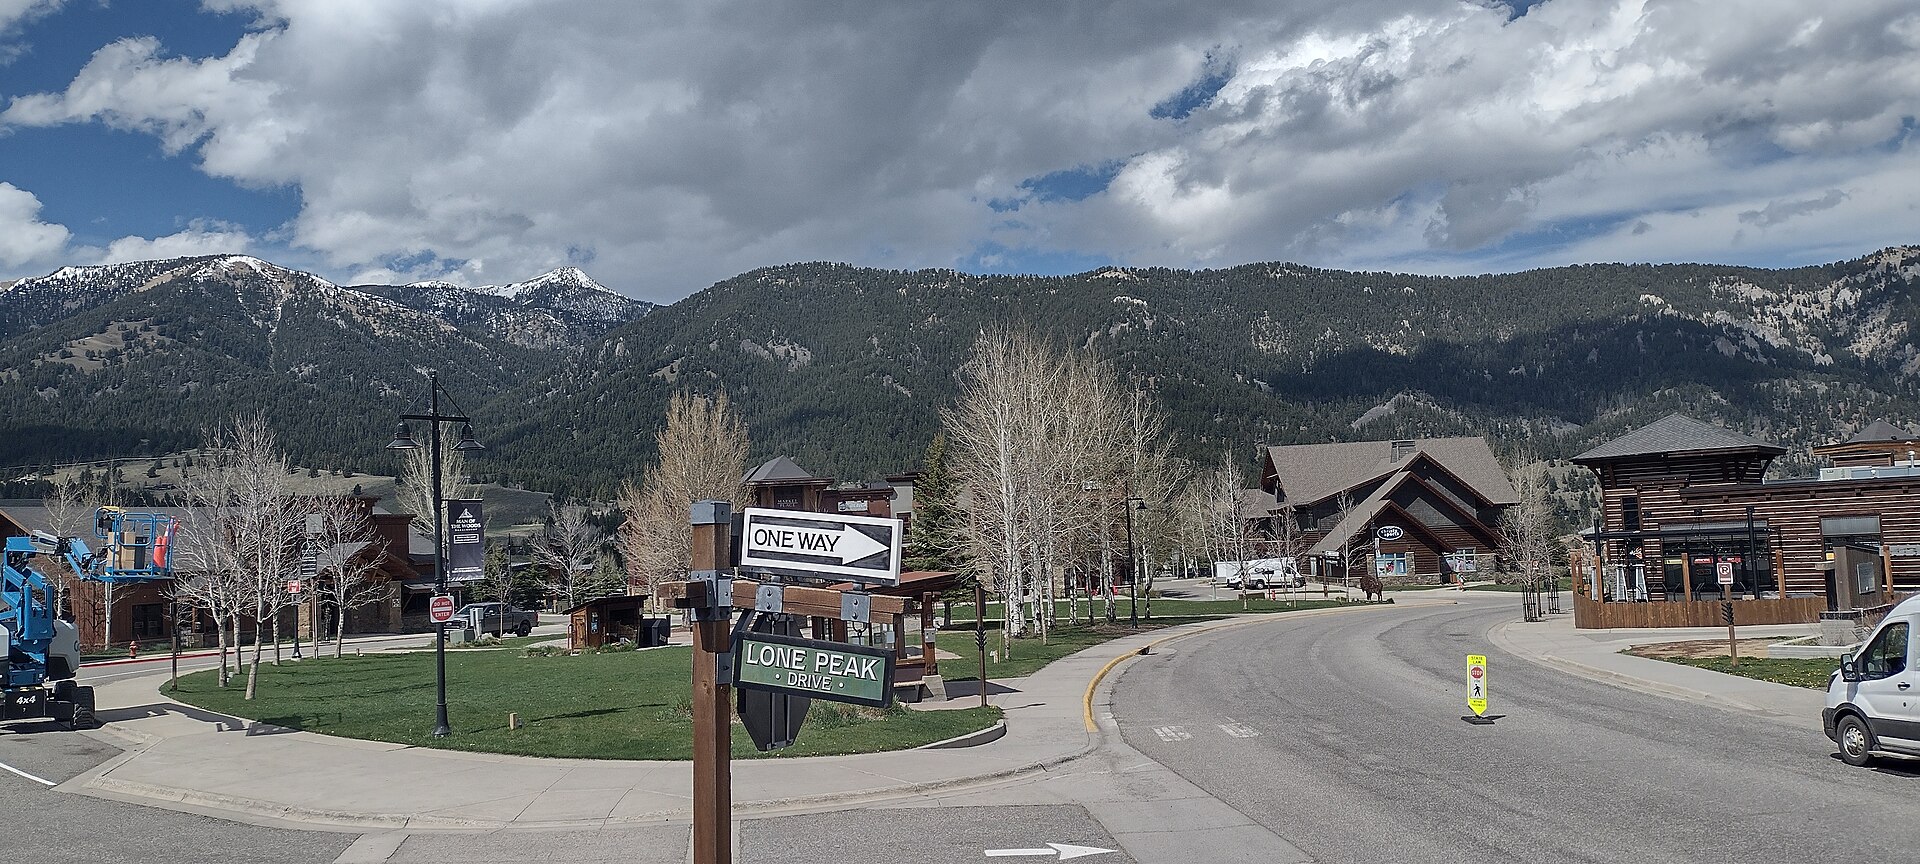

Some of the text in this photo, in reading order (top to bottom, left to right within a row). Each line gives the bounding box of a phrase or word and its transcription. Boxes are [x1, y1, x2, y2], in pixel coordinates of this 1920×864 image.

[754, 529, 841, 552] ONE WAY
[746, 643, 881, 681] LONE PEAK
[787, 672, 833, 691] DRIVE
[16, 695, 36, 704] 4x4
